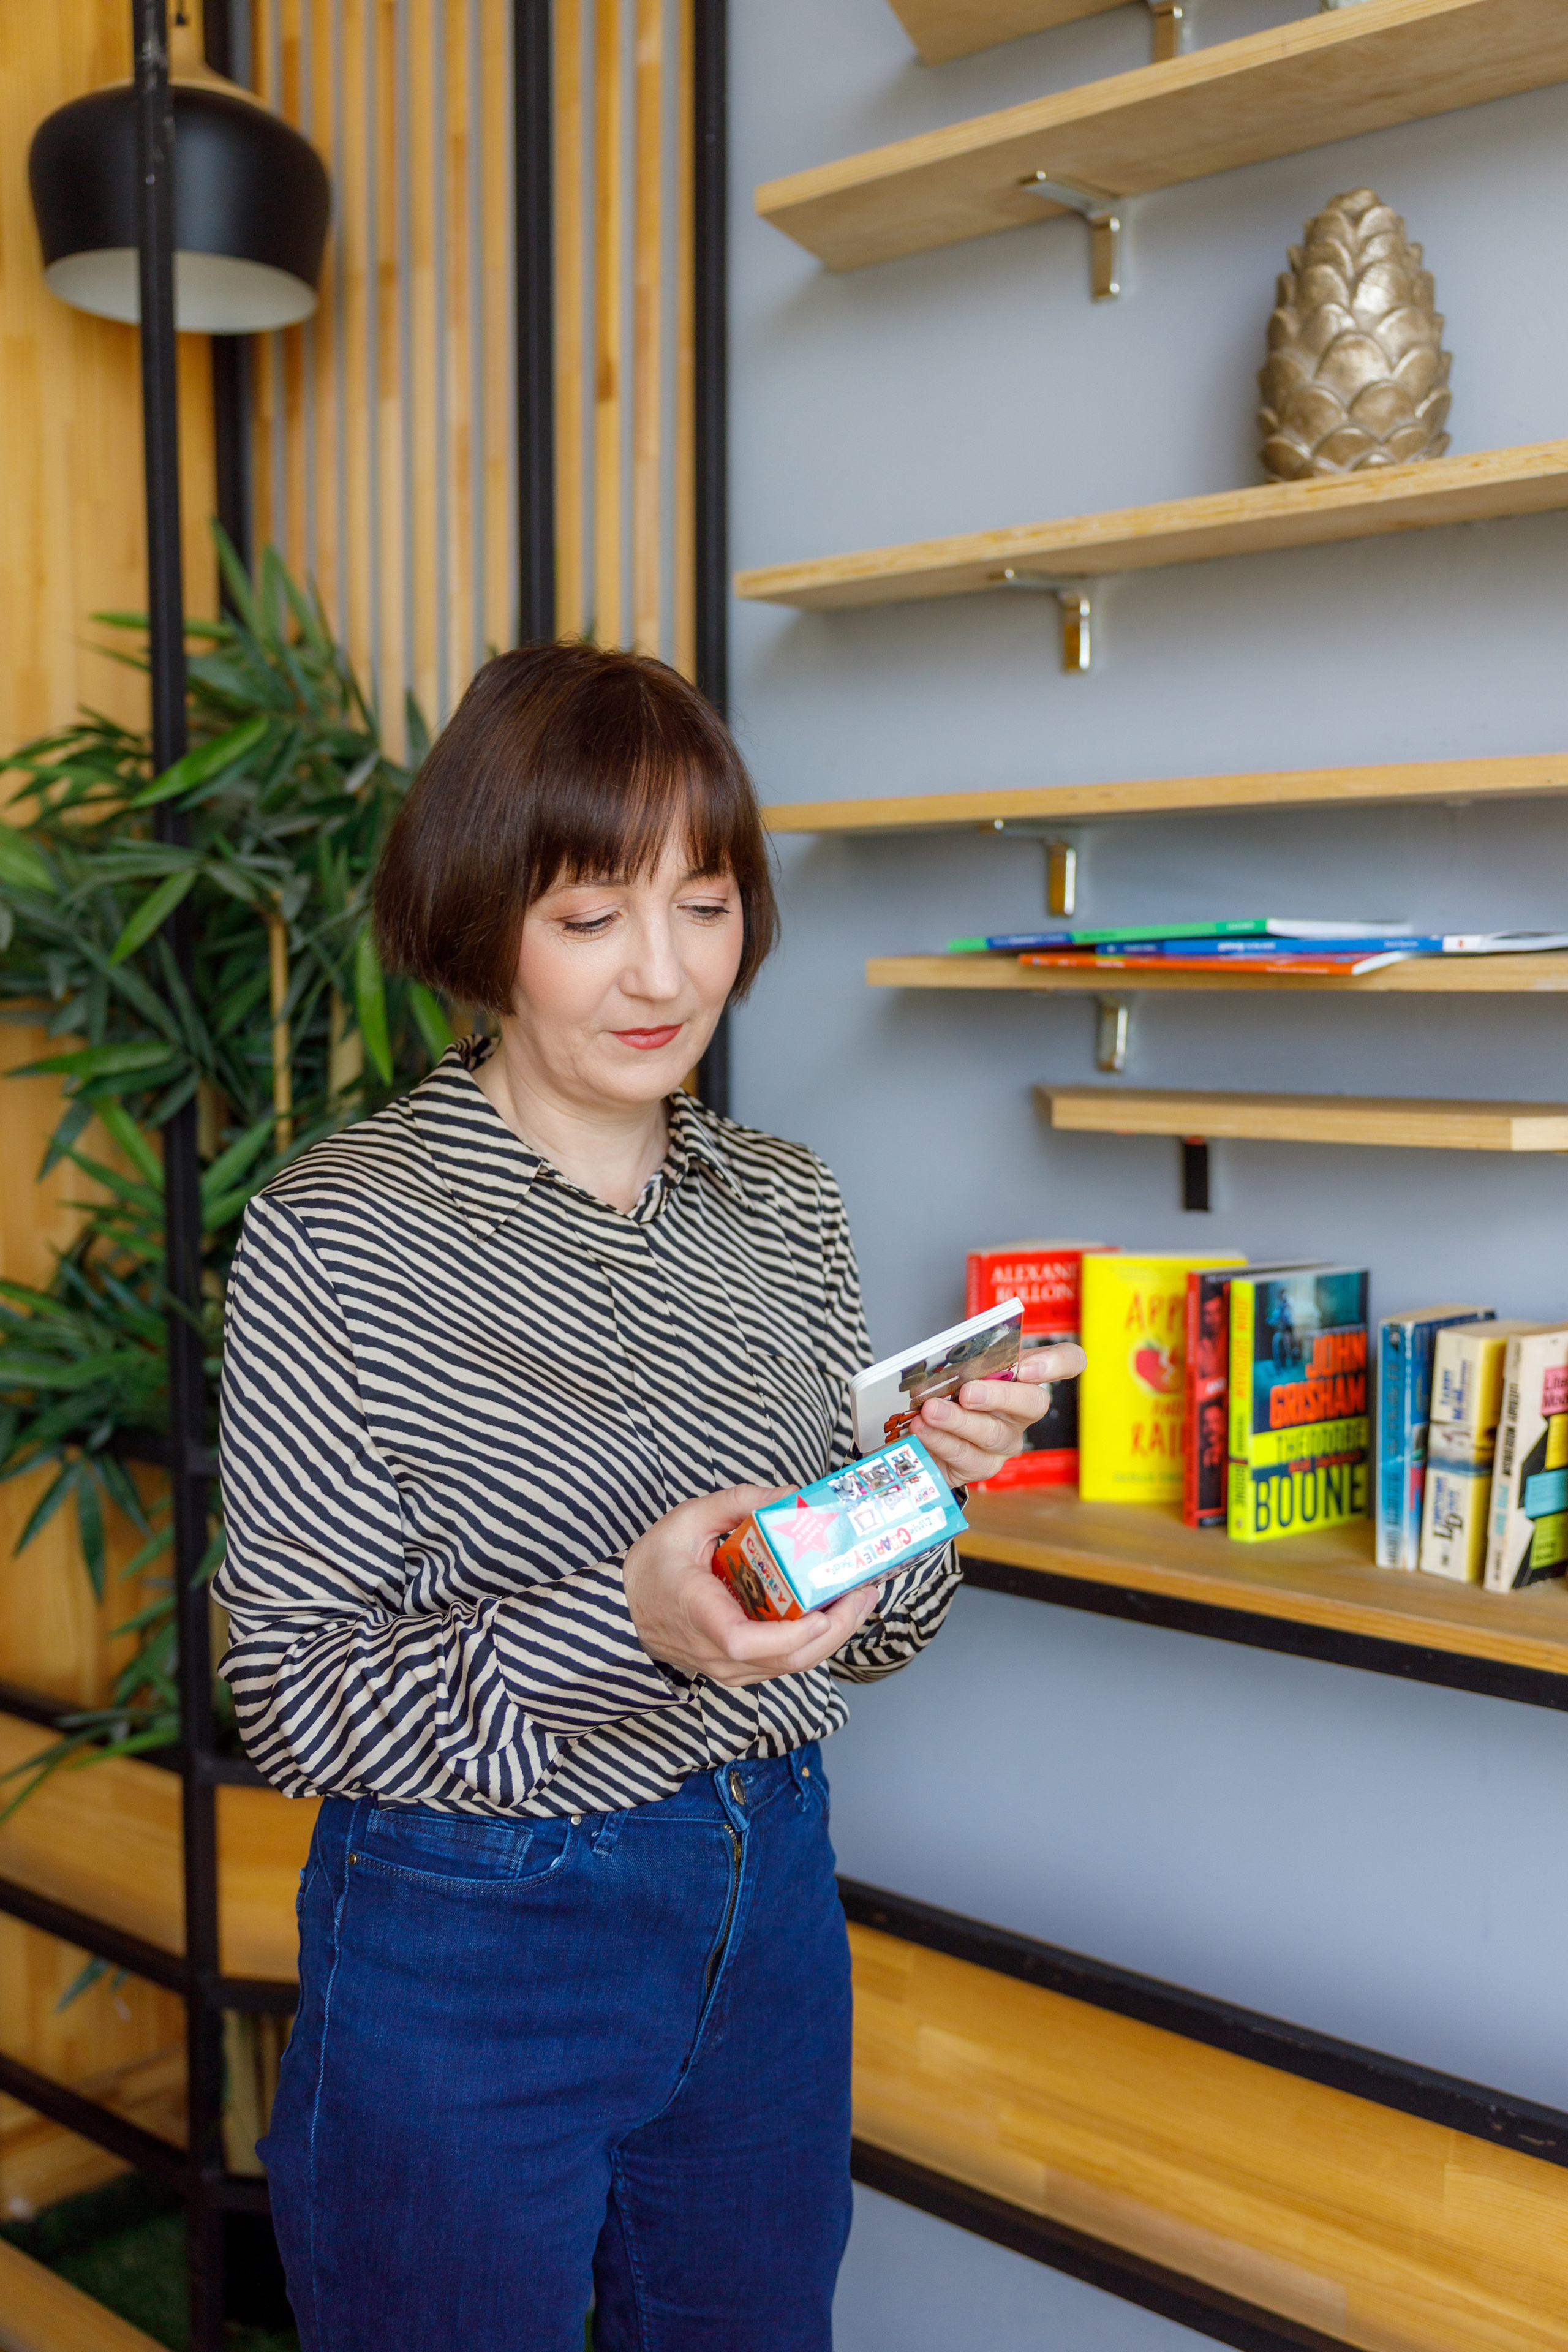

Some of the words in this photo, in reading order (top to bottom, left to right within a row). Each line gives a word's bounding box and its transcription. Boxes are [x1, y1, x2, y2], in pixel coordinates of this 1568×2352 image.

[1306, 1330, 1367, 1379] JOHN
[1269, 1374, 1366, 1430] GRISHAM
[1255, 1465, 1365, 1531] BOONE
[855, 1527, 911, 1569] CHARLEY
[910, 1516, 933, 1534] Little
[746, 1537, 787, 1602] CHARLEY
